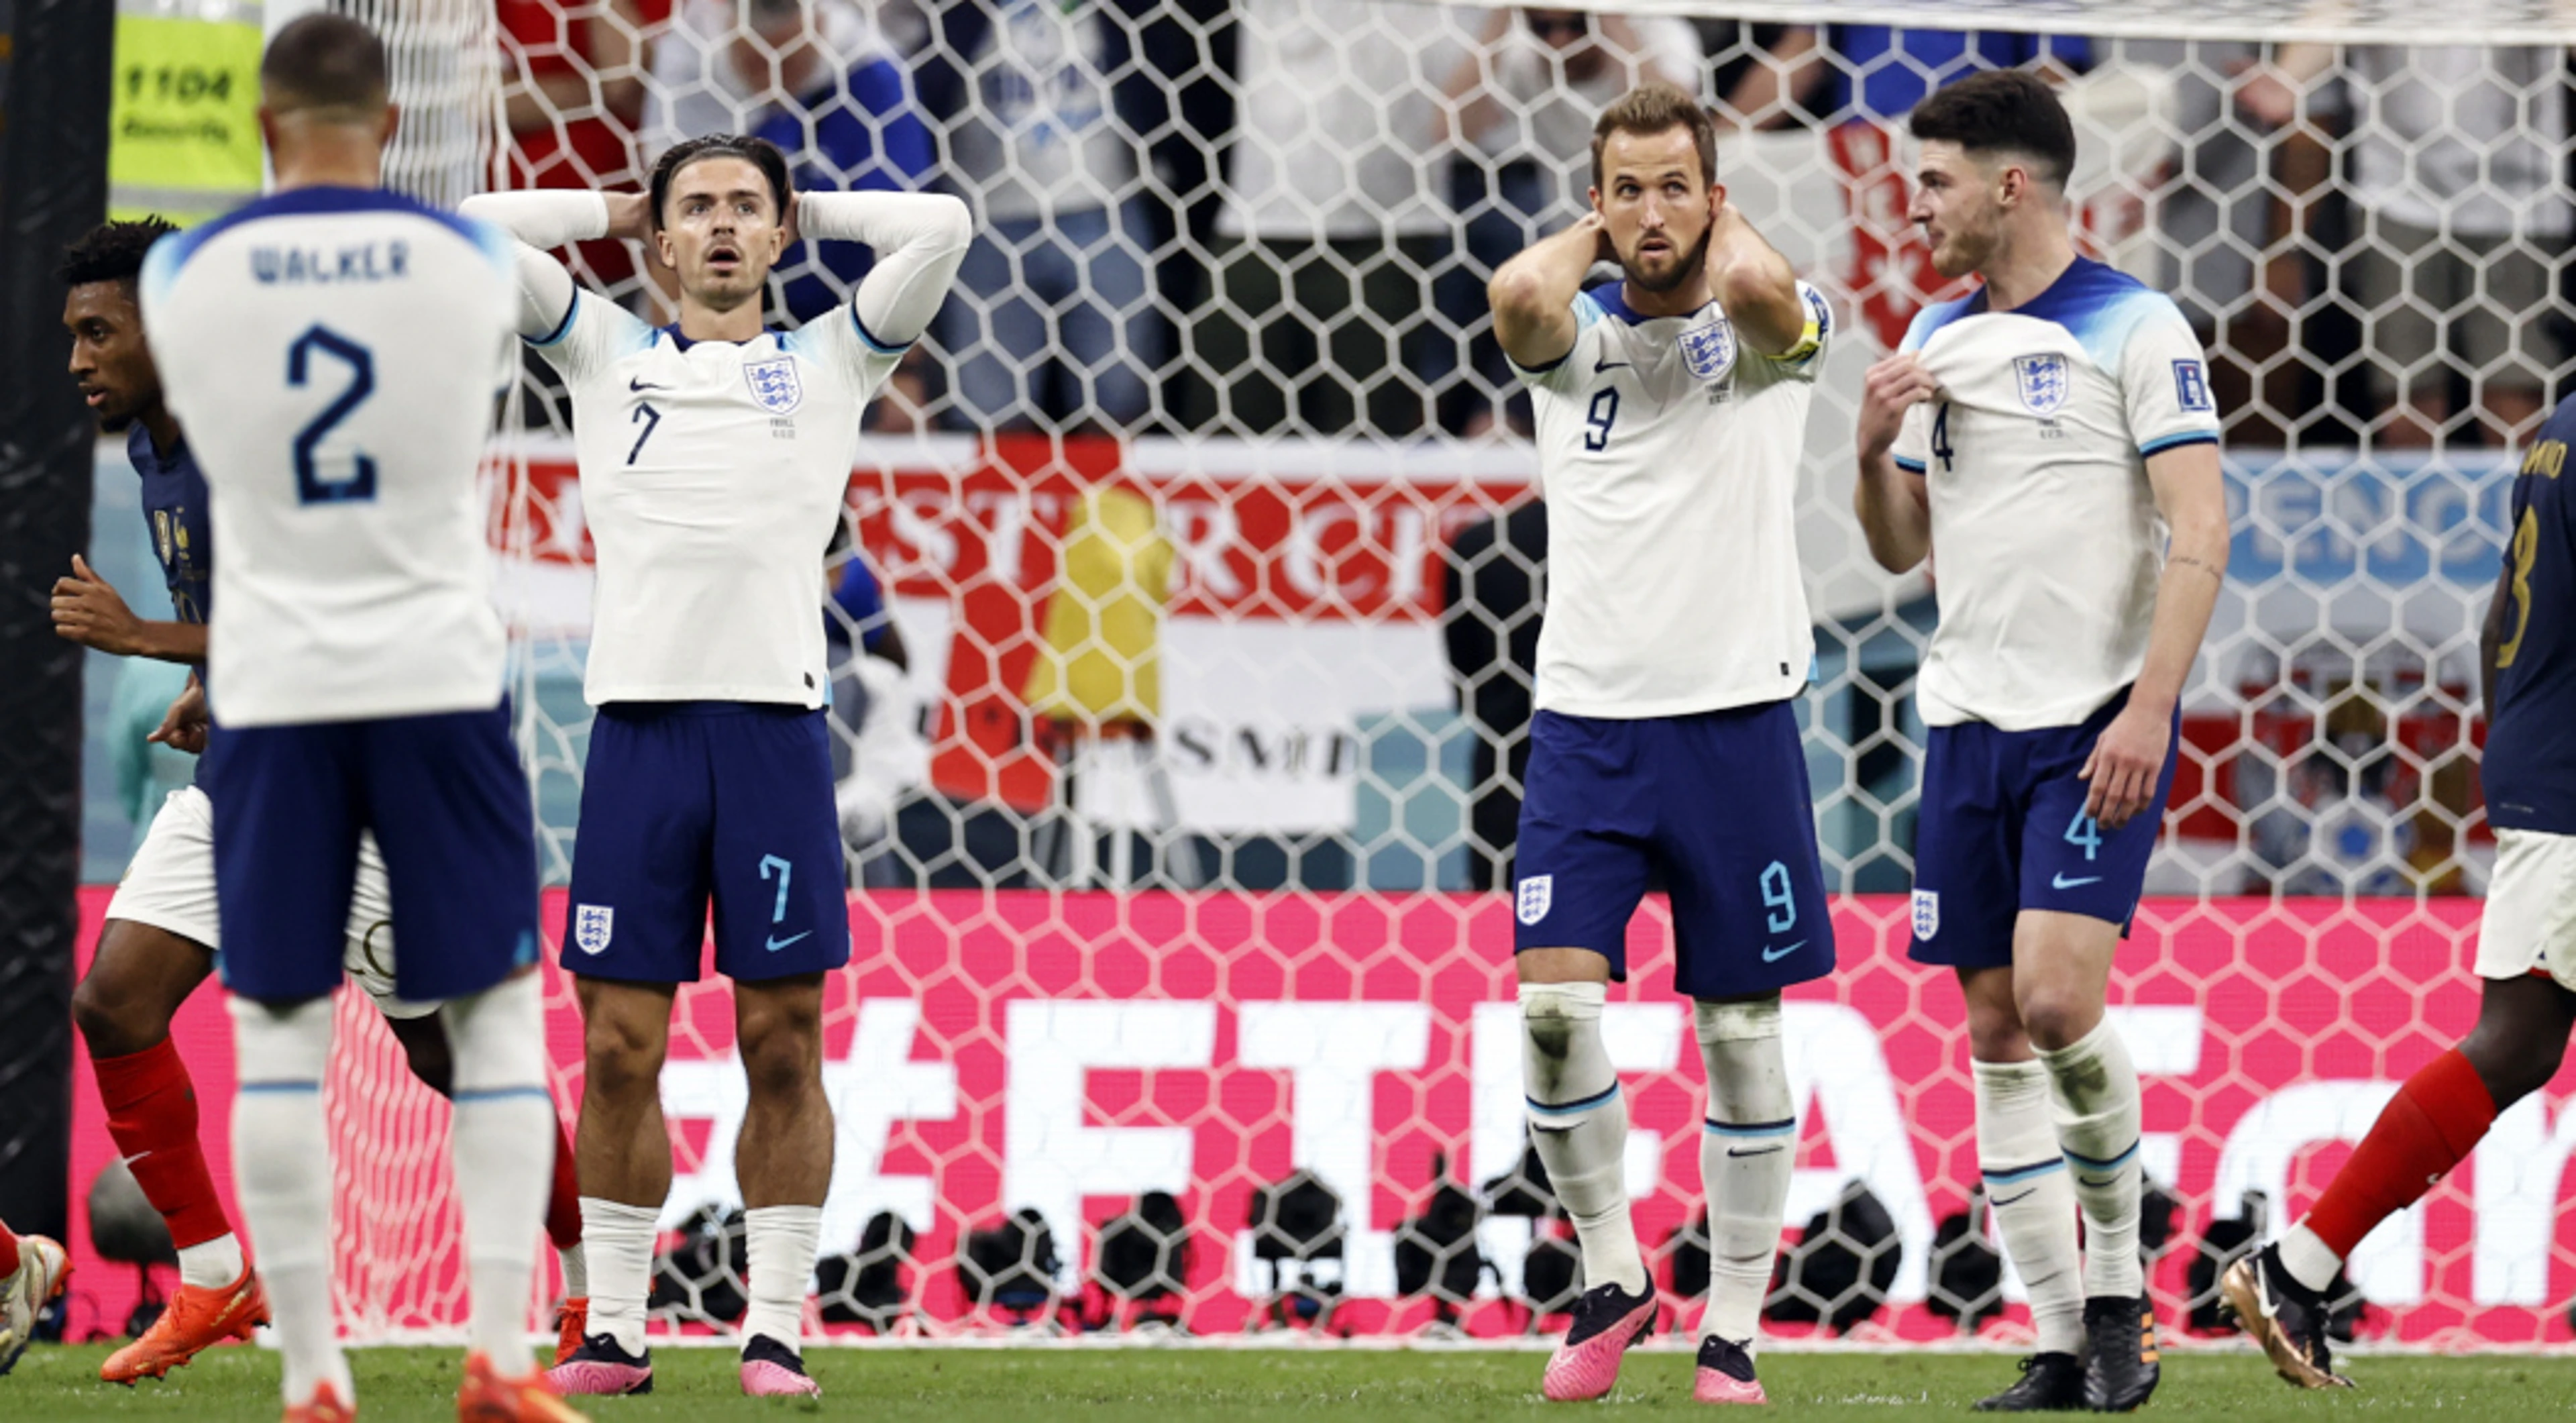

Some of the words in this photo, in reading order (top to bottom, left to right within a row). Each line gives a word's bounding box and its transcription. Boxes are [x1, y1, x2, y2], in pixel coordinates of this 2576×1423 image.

[250, 239, 410, 284] WALKER
[287, 322, 377, 506] 2
[627, 401, 661, 465] 7
[1585, 384, 1620, 452] 9
[1931, 401, 1953, 472] 4
[2063, 801, 2102, 861] 4
[759, 853, 792, 923] 7
[1760, 860, 1796, 933] 9
